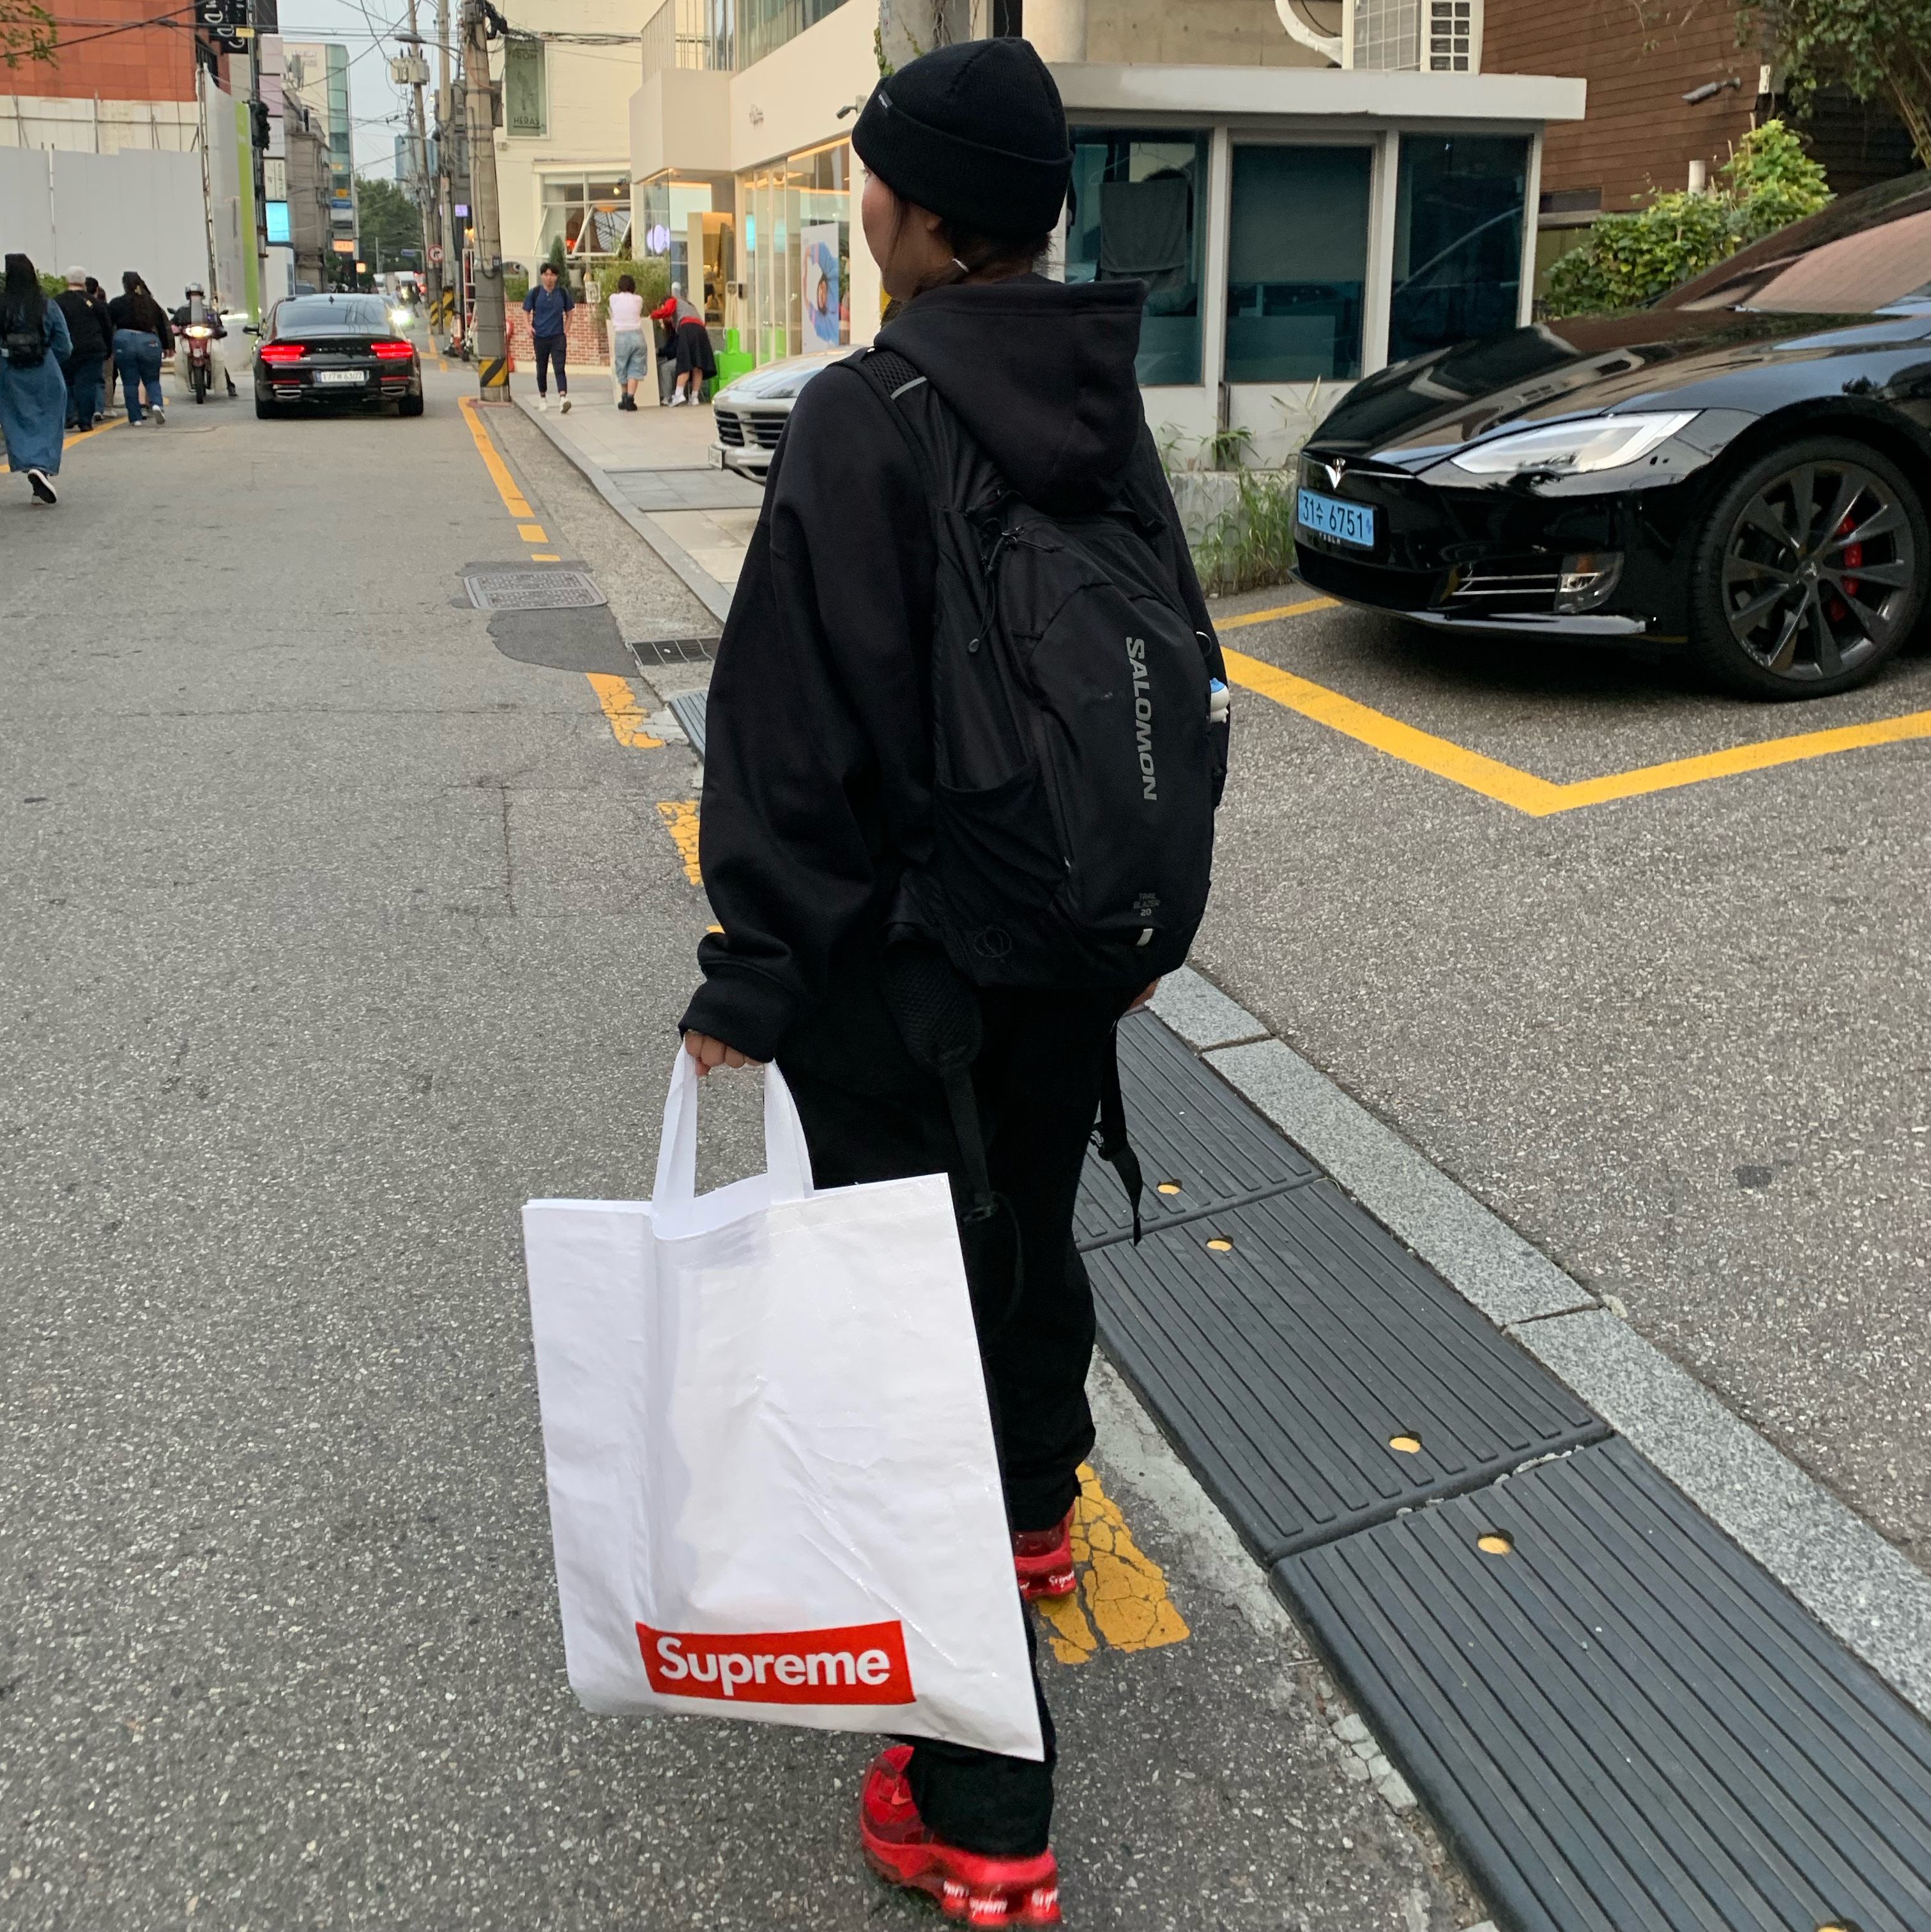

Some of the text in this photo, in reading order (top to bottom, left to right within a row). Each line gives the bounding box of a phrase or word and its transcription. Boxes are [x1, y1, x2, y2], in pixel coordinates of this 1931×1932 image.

[514, 116, 540, 125] HERAS
[1303, 496, 1363, 539] 31수 6751
[1126, 636, 1157, 801] SALOMON
[1140, 908, 1152, 916] 20
[656, 1636, 891, 1696] Supreme
